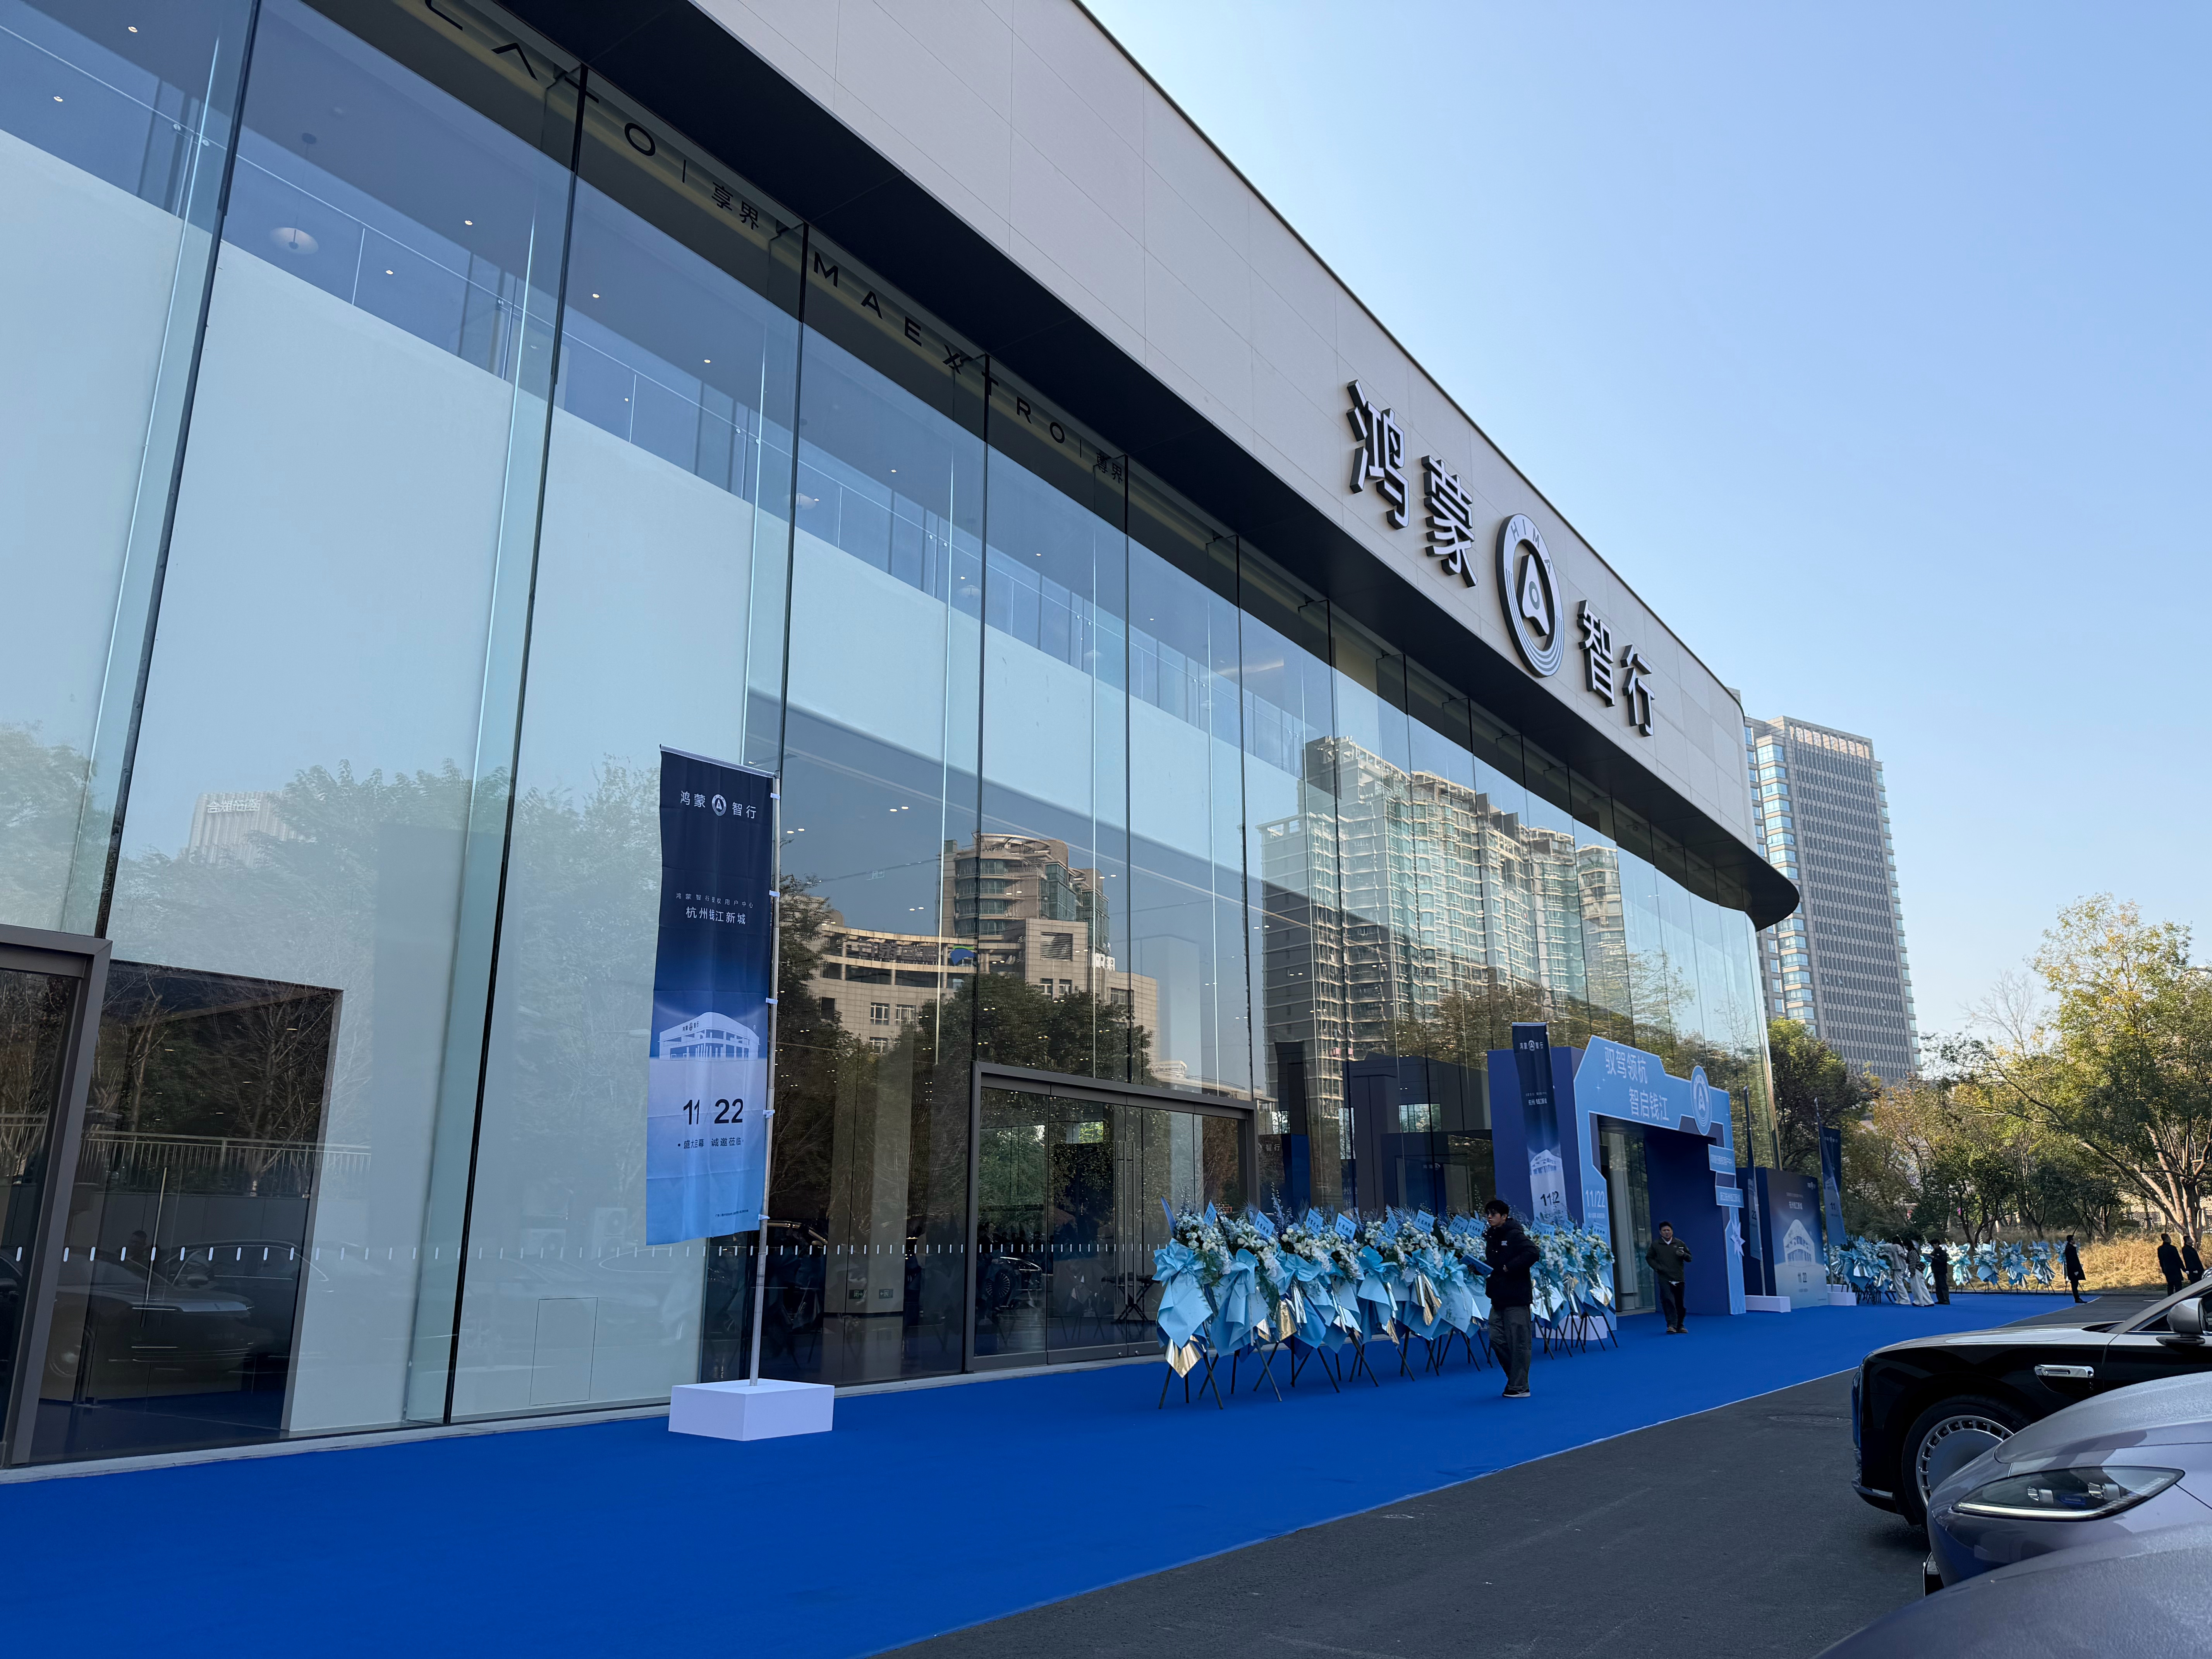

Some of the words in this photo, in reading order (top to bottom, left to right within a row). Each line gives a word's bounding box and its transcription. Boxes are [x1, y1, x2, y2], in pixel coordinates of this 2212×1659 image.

[711, 181, 759, 230] 享界
[814, 251, 1065, 443] MAEXTRO
[1096, 452, 1123, 484] 尊界
[1346, 379, 1478, 588] 鸿蒙
[1577, 599, 1655, 737] 智行
[1511, 519, 1551, 576] HIMA
[680, 790, 706, 808] 鸿蒙
[732, 802, 756, 819] 智行
[676, 893, 753, 908] 鸿蒙智行授权用户中心
[686, 907, 746, 924] 杭州钱江新城
[1604, 1047, 1648, 1084] 驭驾领杭
[1629, 1086, 1669, 1121] 智启钱江
[1585, 1190, 1606, 1208] 11/22
